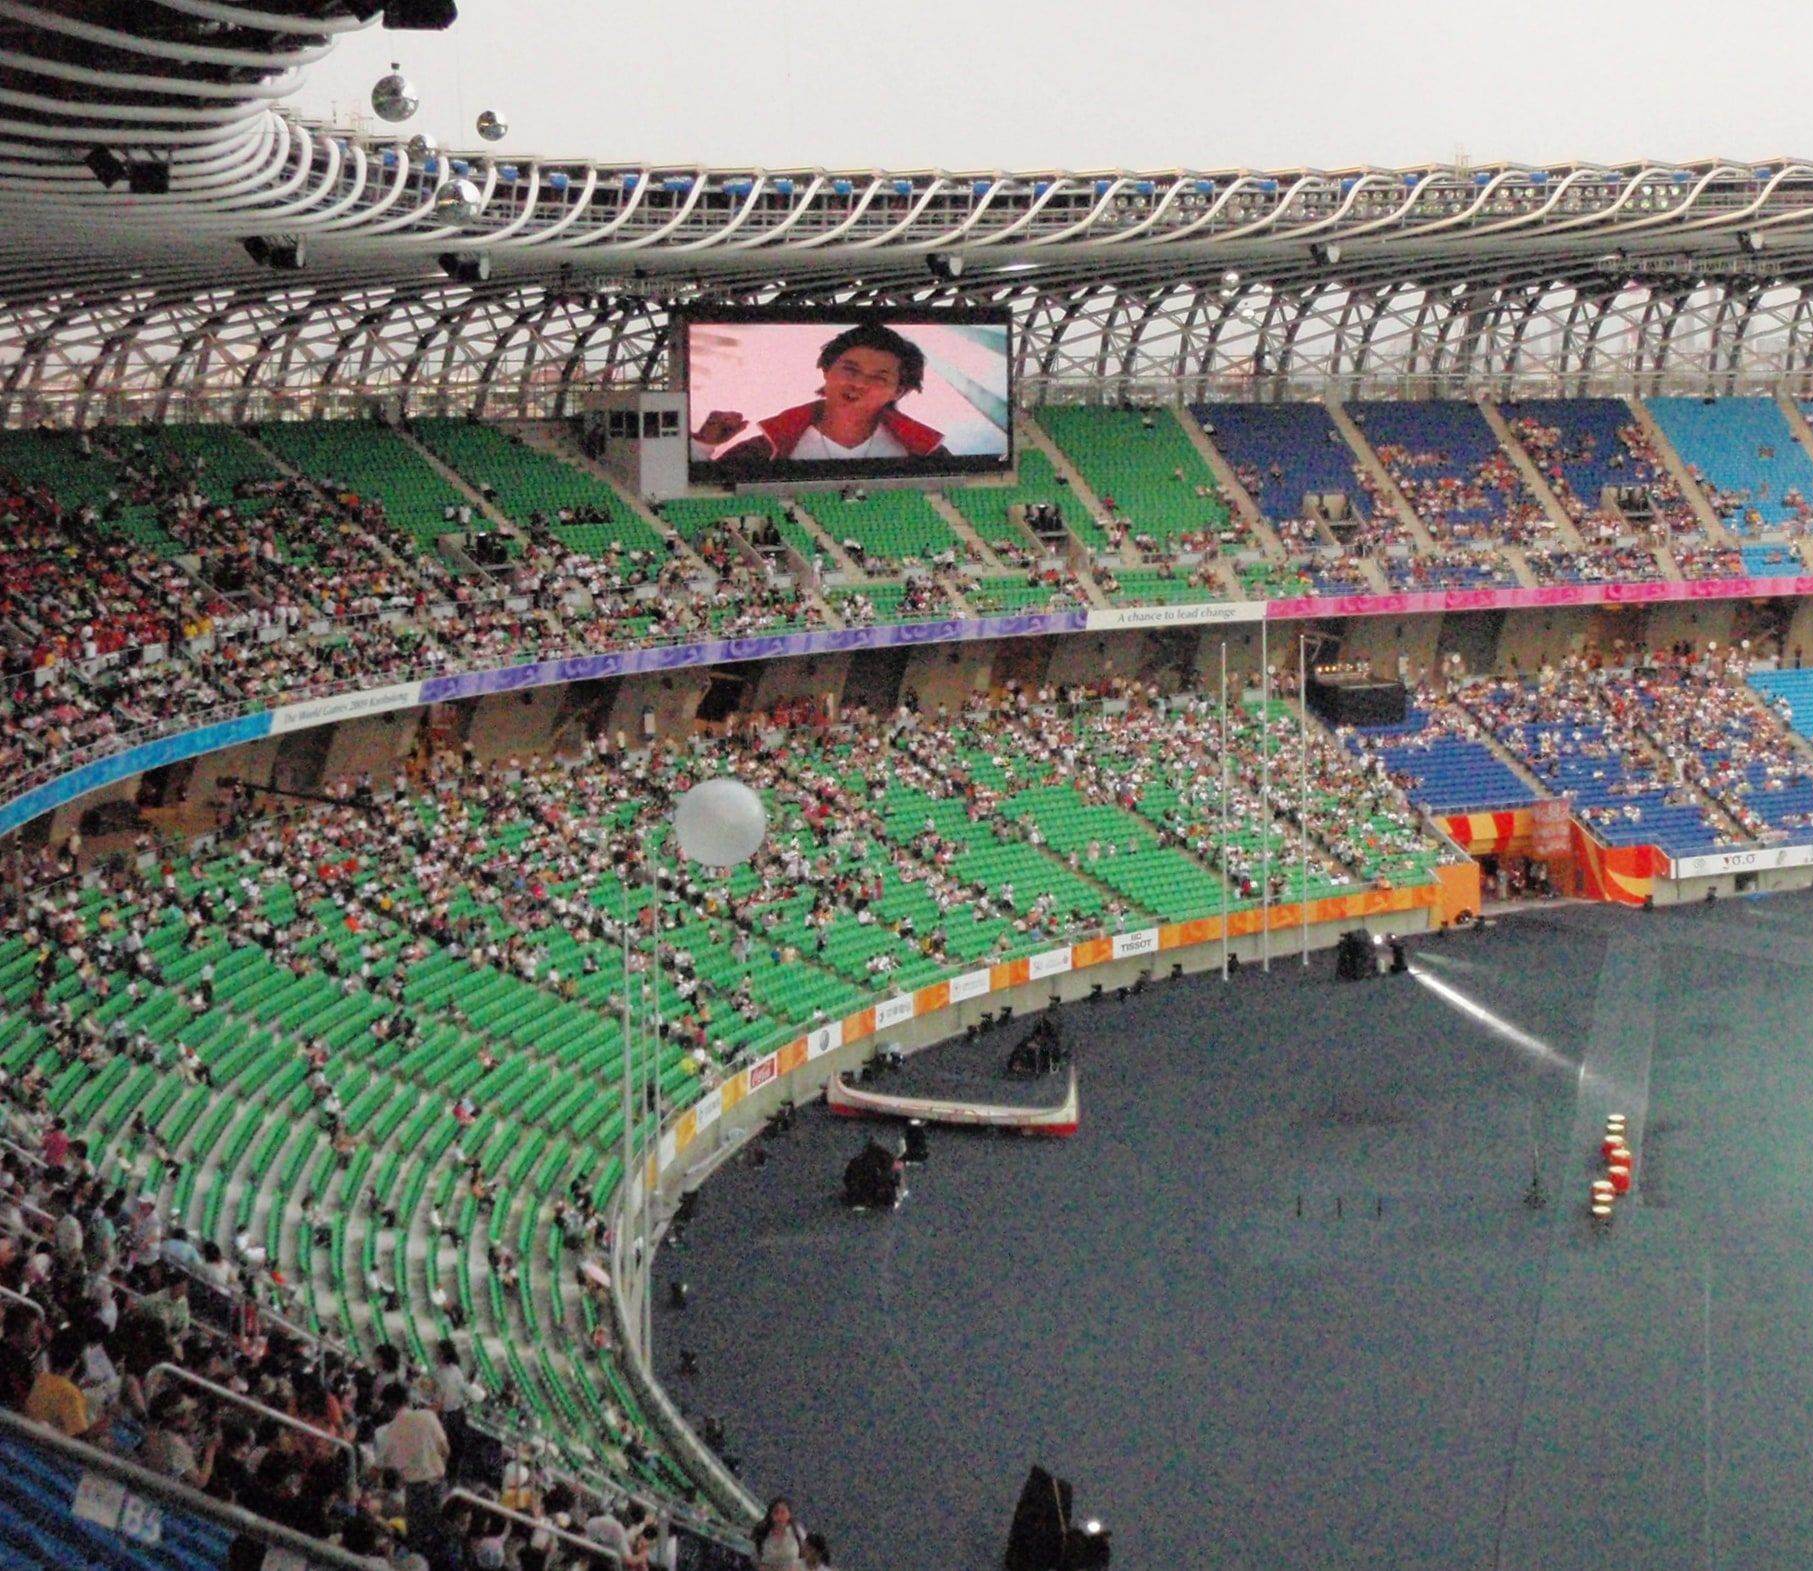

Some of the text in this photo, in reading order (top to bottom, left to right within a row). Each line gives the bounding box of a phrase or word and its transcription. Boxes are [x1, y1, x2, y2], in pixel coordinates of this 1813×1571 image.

[1127, 611, 1162, 622] chance
[1164, 611, 1175, 620] to
[1177, 609, 1198, 620] lead
[1200, 607, 1237, 620] change
[299, 705, 322, 720] World
[1121, 938, 1153, 952] TISSOT
